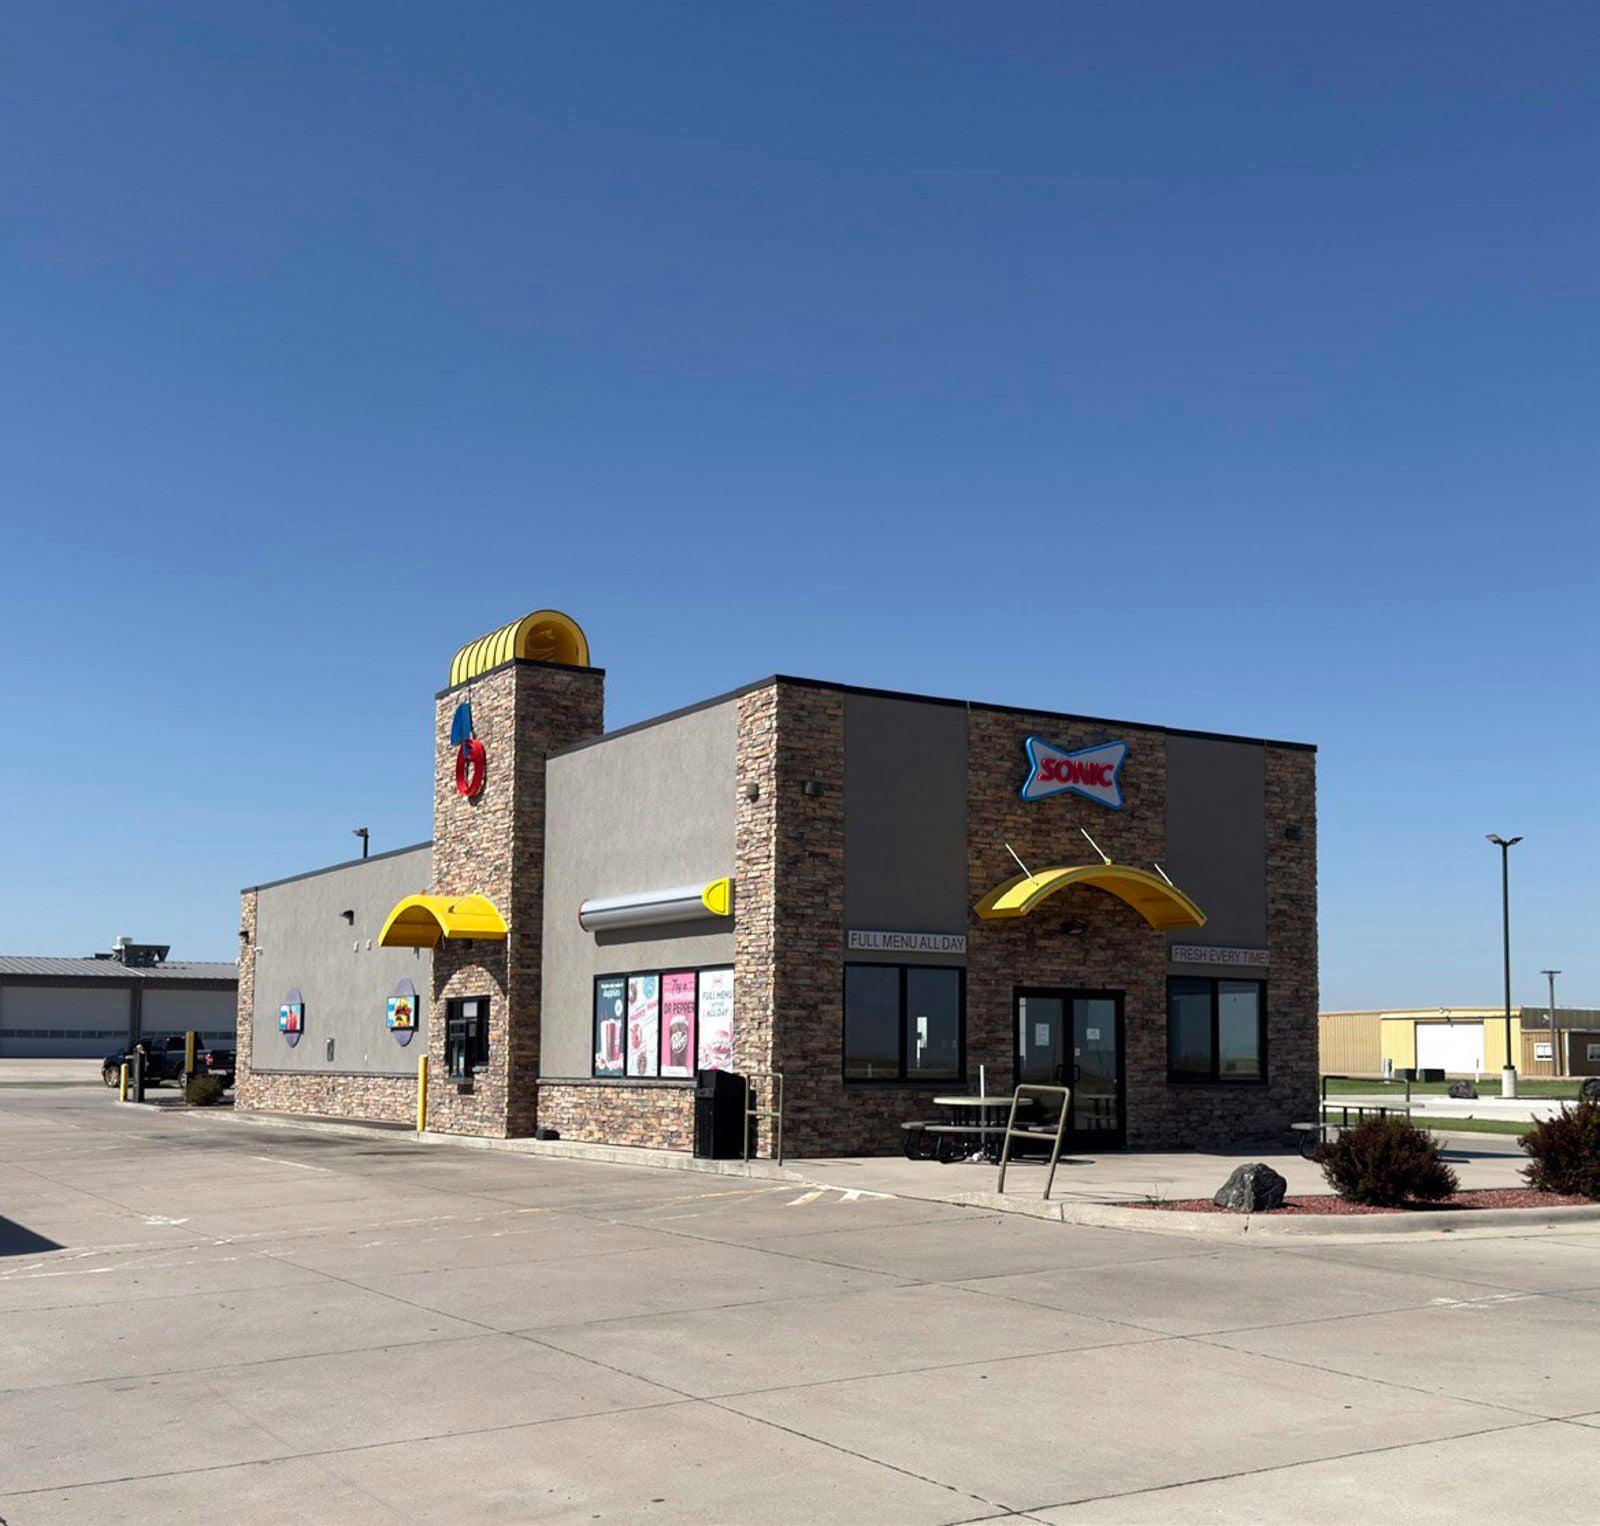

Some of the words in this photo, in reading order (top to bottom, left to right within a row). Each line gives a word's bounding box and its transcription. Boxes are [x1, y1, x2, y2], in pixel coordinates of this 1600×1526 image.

[1037, 757, 1115, 787] SONIC
[850, 932, 879, 948] FULL
[882, 933, 917, 949] MENU
[919, 935, 940, 950] ALL
[942, 936, 964, 951] DAY
[1173, 946, 1207, 961] FRESH
[1208, 948, 1240, 963] EVERY
[703, 991, 715, 1000] FULL
